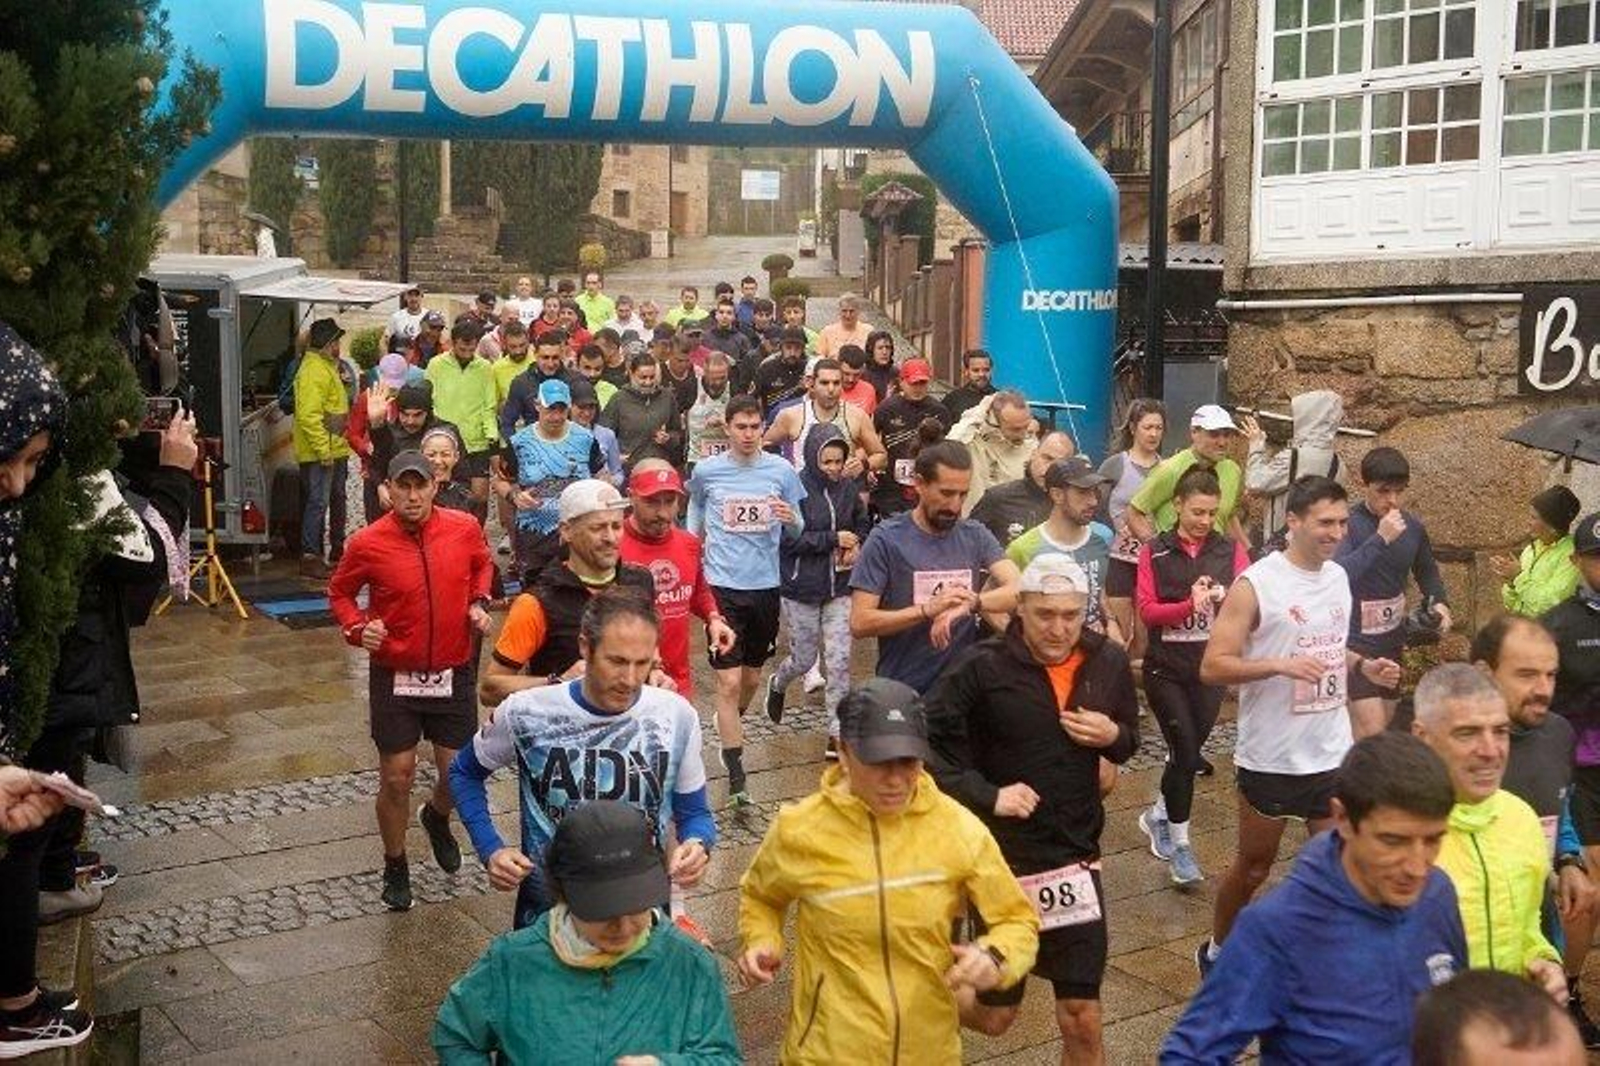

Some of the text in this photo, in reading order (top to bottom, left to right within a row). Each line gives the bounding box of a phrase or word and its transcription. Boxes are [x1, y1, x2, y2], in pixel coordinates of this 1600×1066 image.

[263, 0, 935, 127] DECATHLON
[737, 506, 759, 522] 28
[1382, 607, 1393, 621] 9
[538, 747, 670, 802] ADN
[1039, 882, 1076, 912] 98
